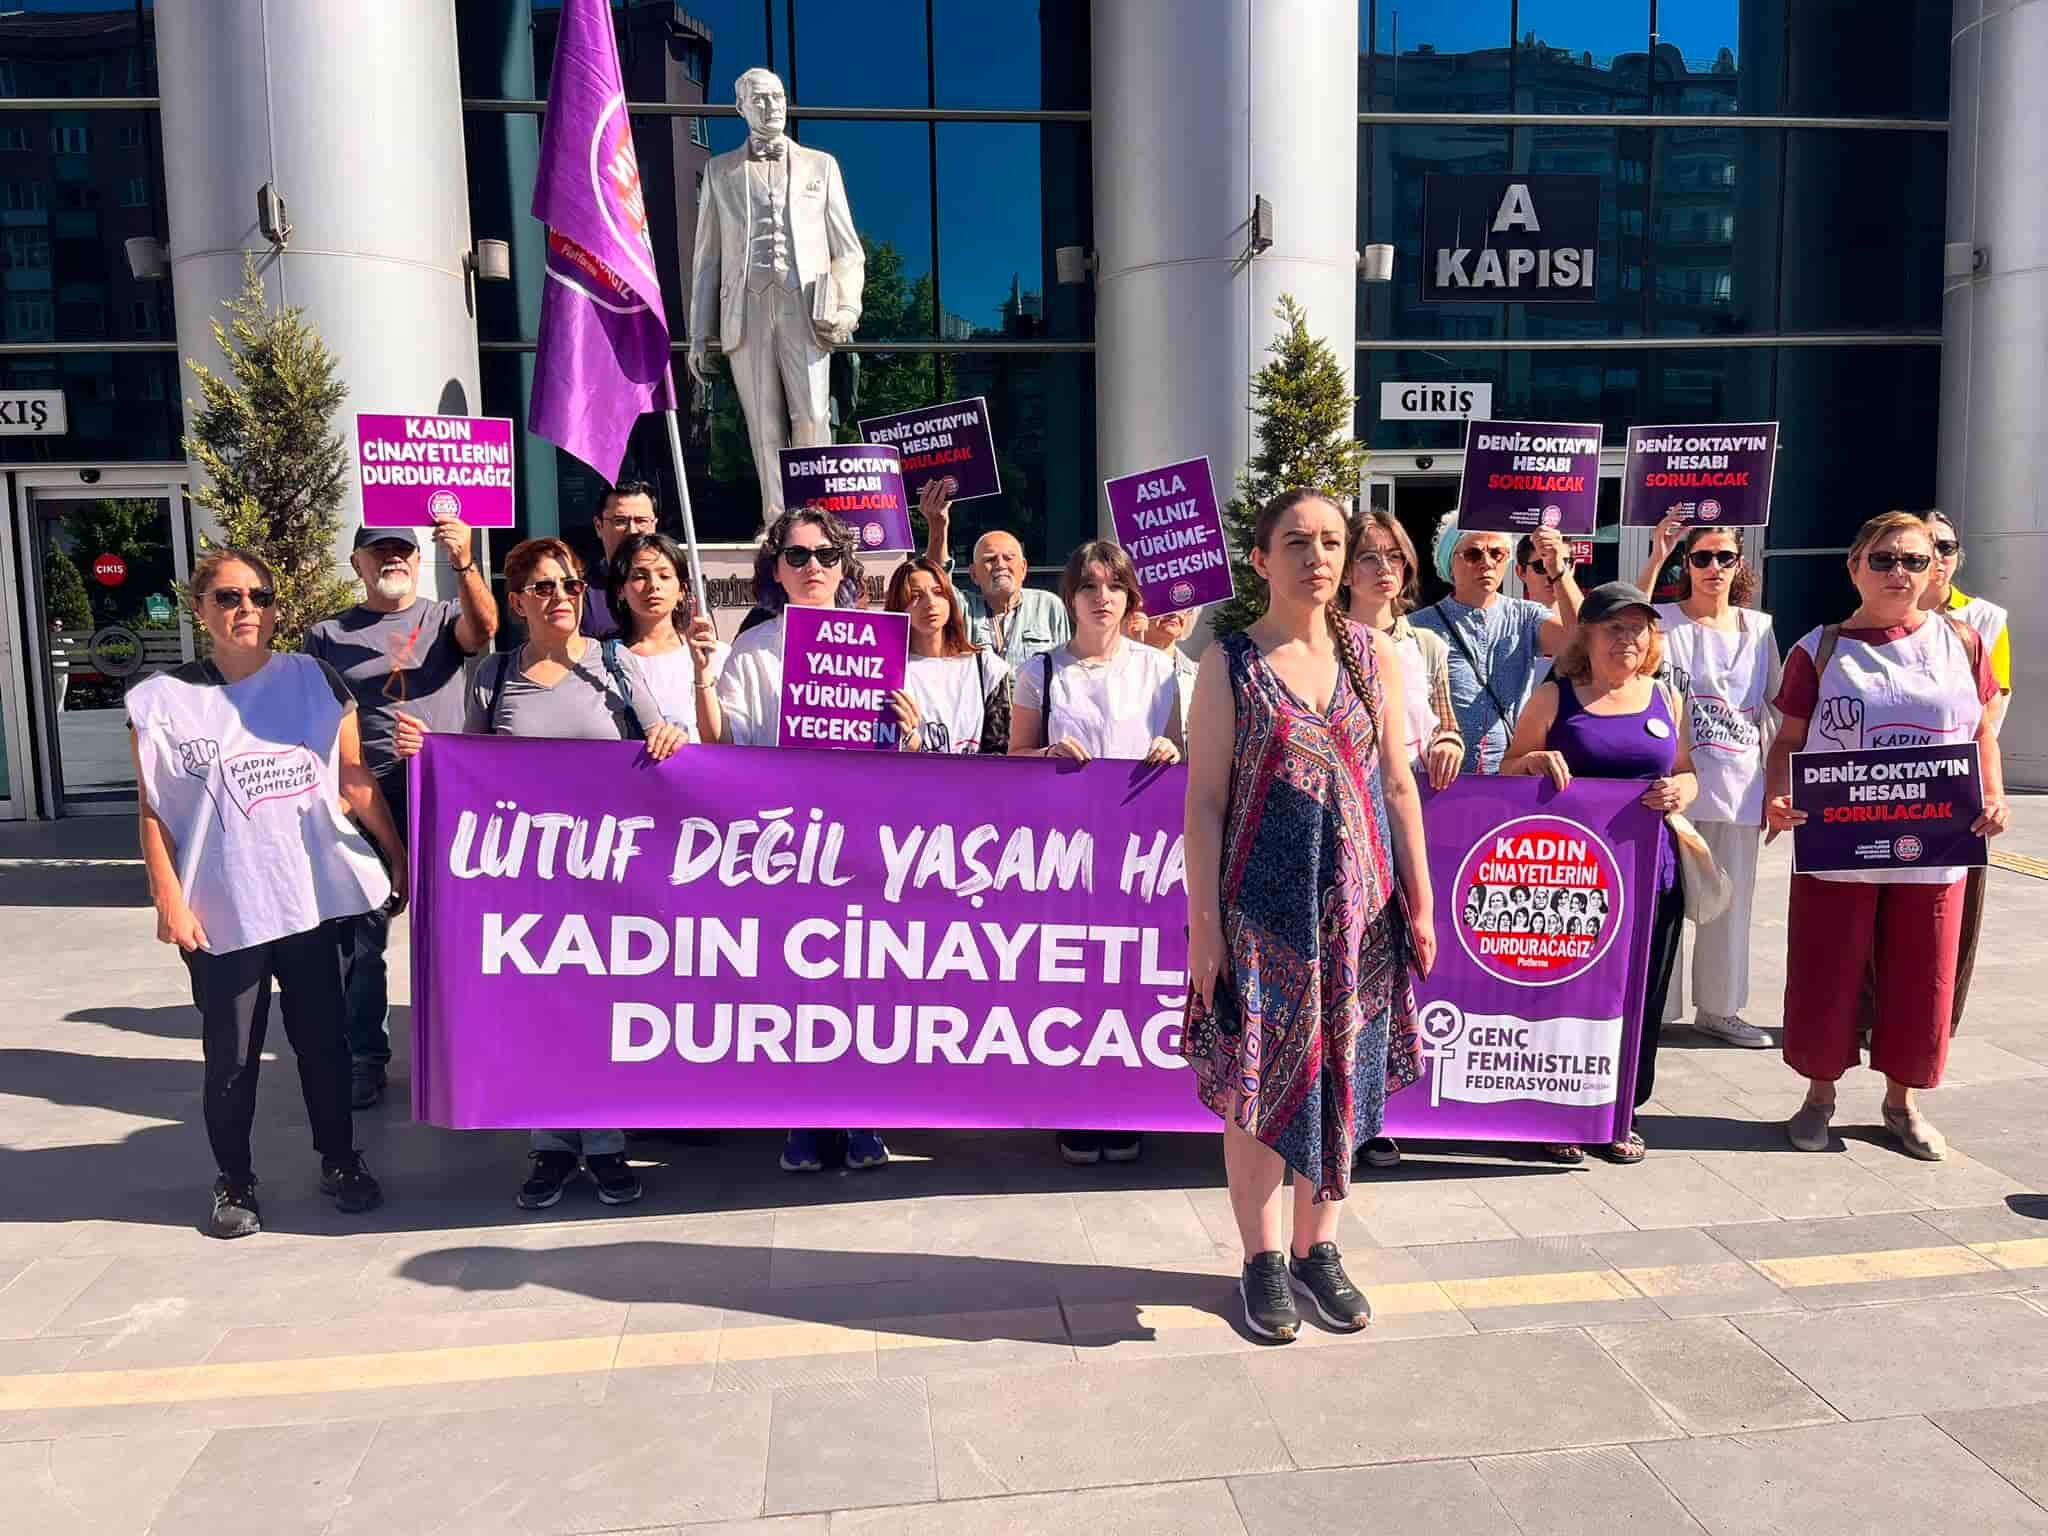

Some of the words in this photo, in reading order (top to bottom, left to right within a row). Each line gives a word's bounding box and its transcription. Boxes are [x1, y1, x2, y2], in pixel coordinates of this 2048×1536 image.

[1491, 184, 1541, 232] A
[1436, 248, 1594, 288] KAPISI
[1401, 385, 1475, 419] GİRİŞ
[405, 418, 471, 440] KADIN
[870, 423, 912, 444] DENİZ
[913, 411, 979, 433] OKTAY'IN
[363, 438, 510, 465] CİNAYETLERİNİ
[902, 434, 953, 455] HESABI
[1477, 431, 1531, 452] DENİZ
[1636, 434, 1683, 453] DENİZ
[1685, 436, 1767, 452] OKTAY'IN
[789, 455, 839, 477] DENİZ
[901, 447, 974, 472] ORULACAK
[1512, 455, 1571, 473] HESABI
[1666, 455, 1729, 470] HESABI
[362, 465, 512, 487] DURDURACAĞIZ
[825, 476, 882, 493] HESABI
[1488, 474, 1584, 492] SORULACAK
[1645, 472, 1749, 487] SORULACAK
[1136, 474, 1186, 503] ASLA
[1132, 498, 1200, 530] YALNIZ
[816, 620, 877, 647] ASLA
[806, 652, 885, 679] YALNIZ
[785, 715, 898, 744] YECEKSİN
[1872, 734, 1932, 749] KADIN
[230, 757, 276, 778] KADIN
[1803, 761, 1868, 784] DENİZ
[1870, 758, 1969, 781] OKTAY'IN
[1849, 782, 1926, 802] HESABI
[1823, 802, 1953, 823] SORULACAK
[449, 800, 655, 883] LÜTUF
[669, 807, 855, 887] DEĞİL
[879, 823, 1093, 909] YAŞAM
[1495, 837, 1587, 862] KADIN
[1479, 859, 1598, 885] CİNAYETLERİNİ
[481, 913, 759, 977] KADIN
[783, 904, 1188, 986] CİNAYETL
[1480, 933, 1591, 958] DURDURACAĞIZ
[1468, 1027, 1529, 1050] GENÇ
[1465, 1075, 1581, 1092] FEDERASYONU
